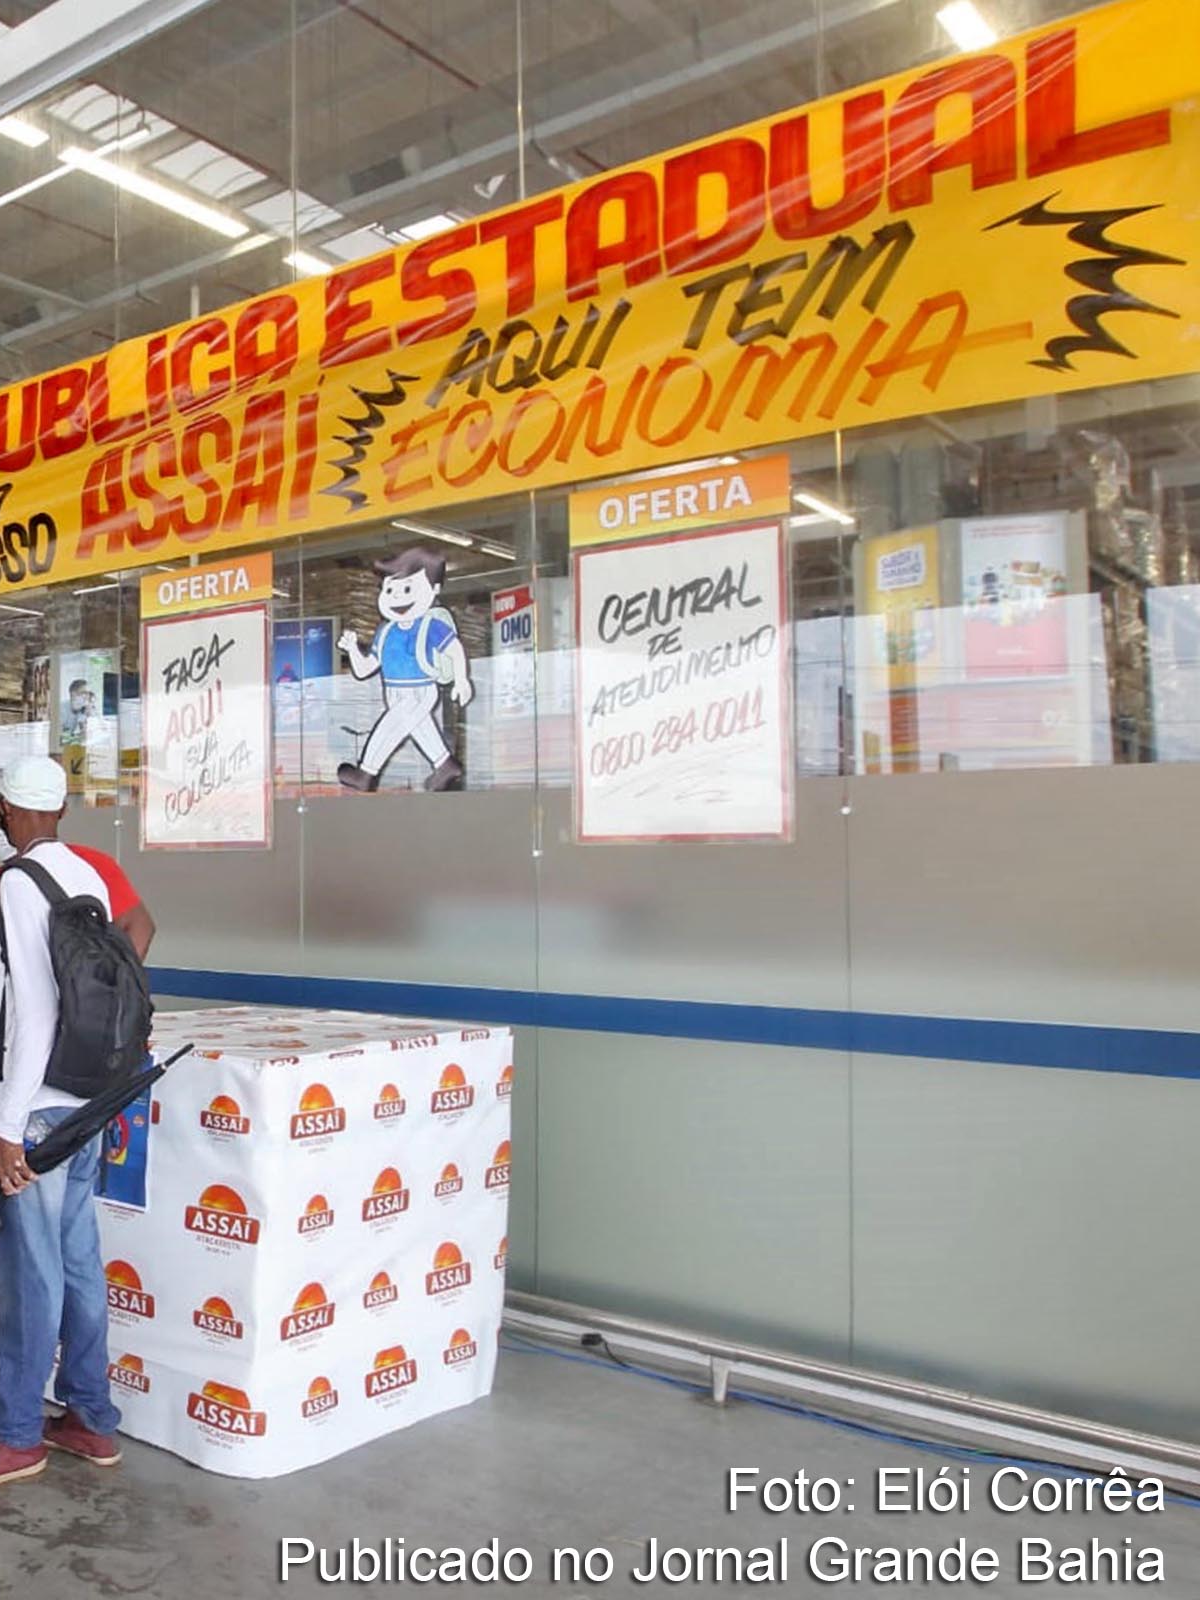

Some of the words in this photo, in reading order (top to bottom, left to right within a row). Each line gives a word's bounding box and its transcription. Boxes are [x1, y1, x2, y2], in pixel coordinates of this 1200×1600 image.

[319, 29, 1171, 368] ESTADUAL
[426, 300, 631, 408] AQUI
[683, 220, 915, 351] TEM
[382, 290, 1033, 497] ECONOMIA
[599, 475, 752, 529] OFERTA
[158, 567, 249, 605] OFERTA
[598, 561, 762, 643] CENTRAL
[501, 613, 531, 643] OMO
[648, 627, 683, 660] DE
[588, 624, 777, 727] ATENDIMENTO
[164, 678, 223, 751] AQUI
[590, 730, 645, 777] 0800
